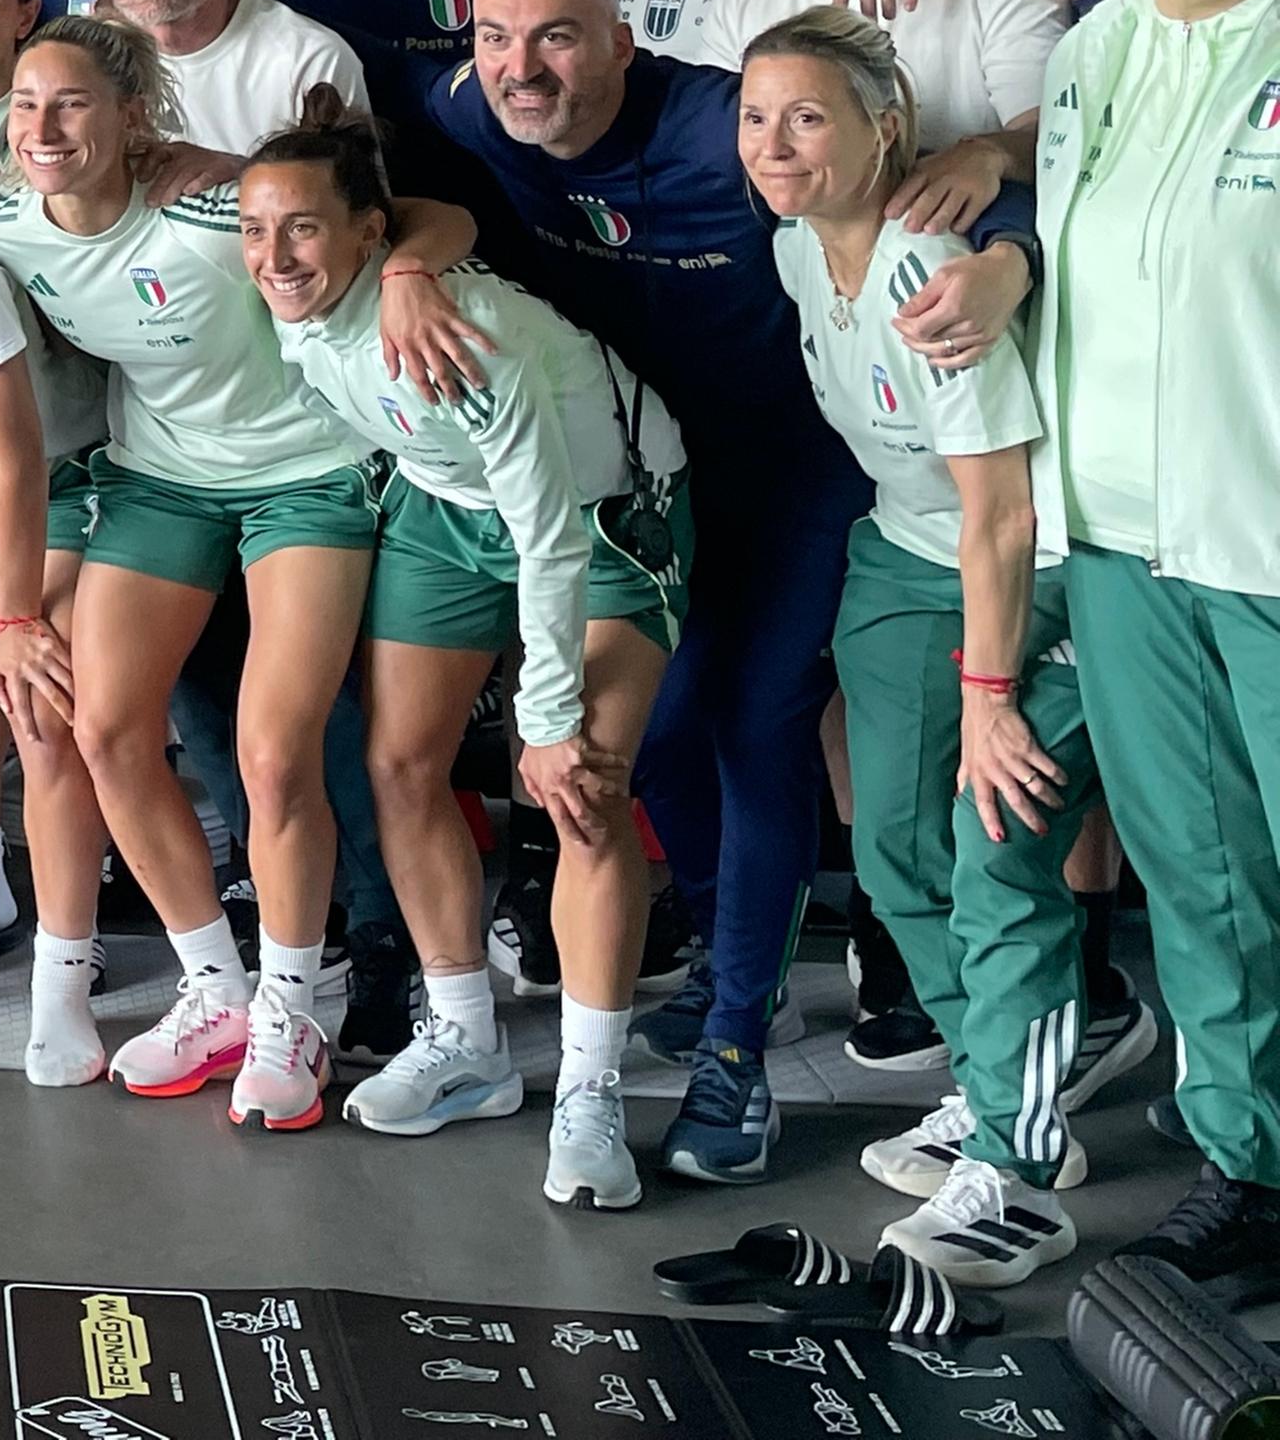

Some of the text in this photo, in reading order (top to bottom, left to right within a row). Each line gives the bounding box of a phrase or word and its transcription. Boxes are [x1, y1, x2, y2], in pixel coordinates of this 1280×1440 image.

[405, 36, 454, 50] Poste
[1214, 174, 1249, 189] eni
[677, 254, 706, 270] eni
[146, 336, 173, 348] eni
